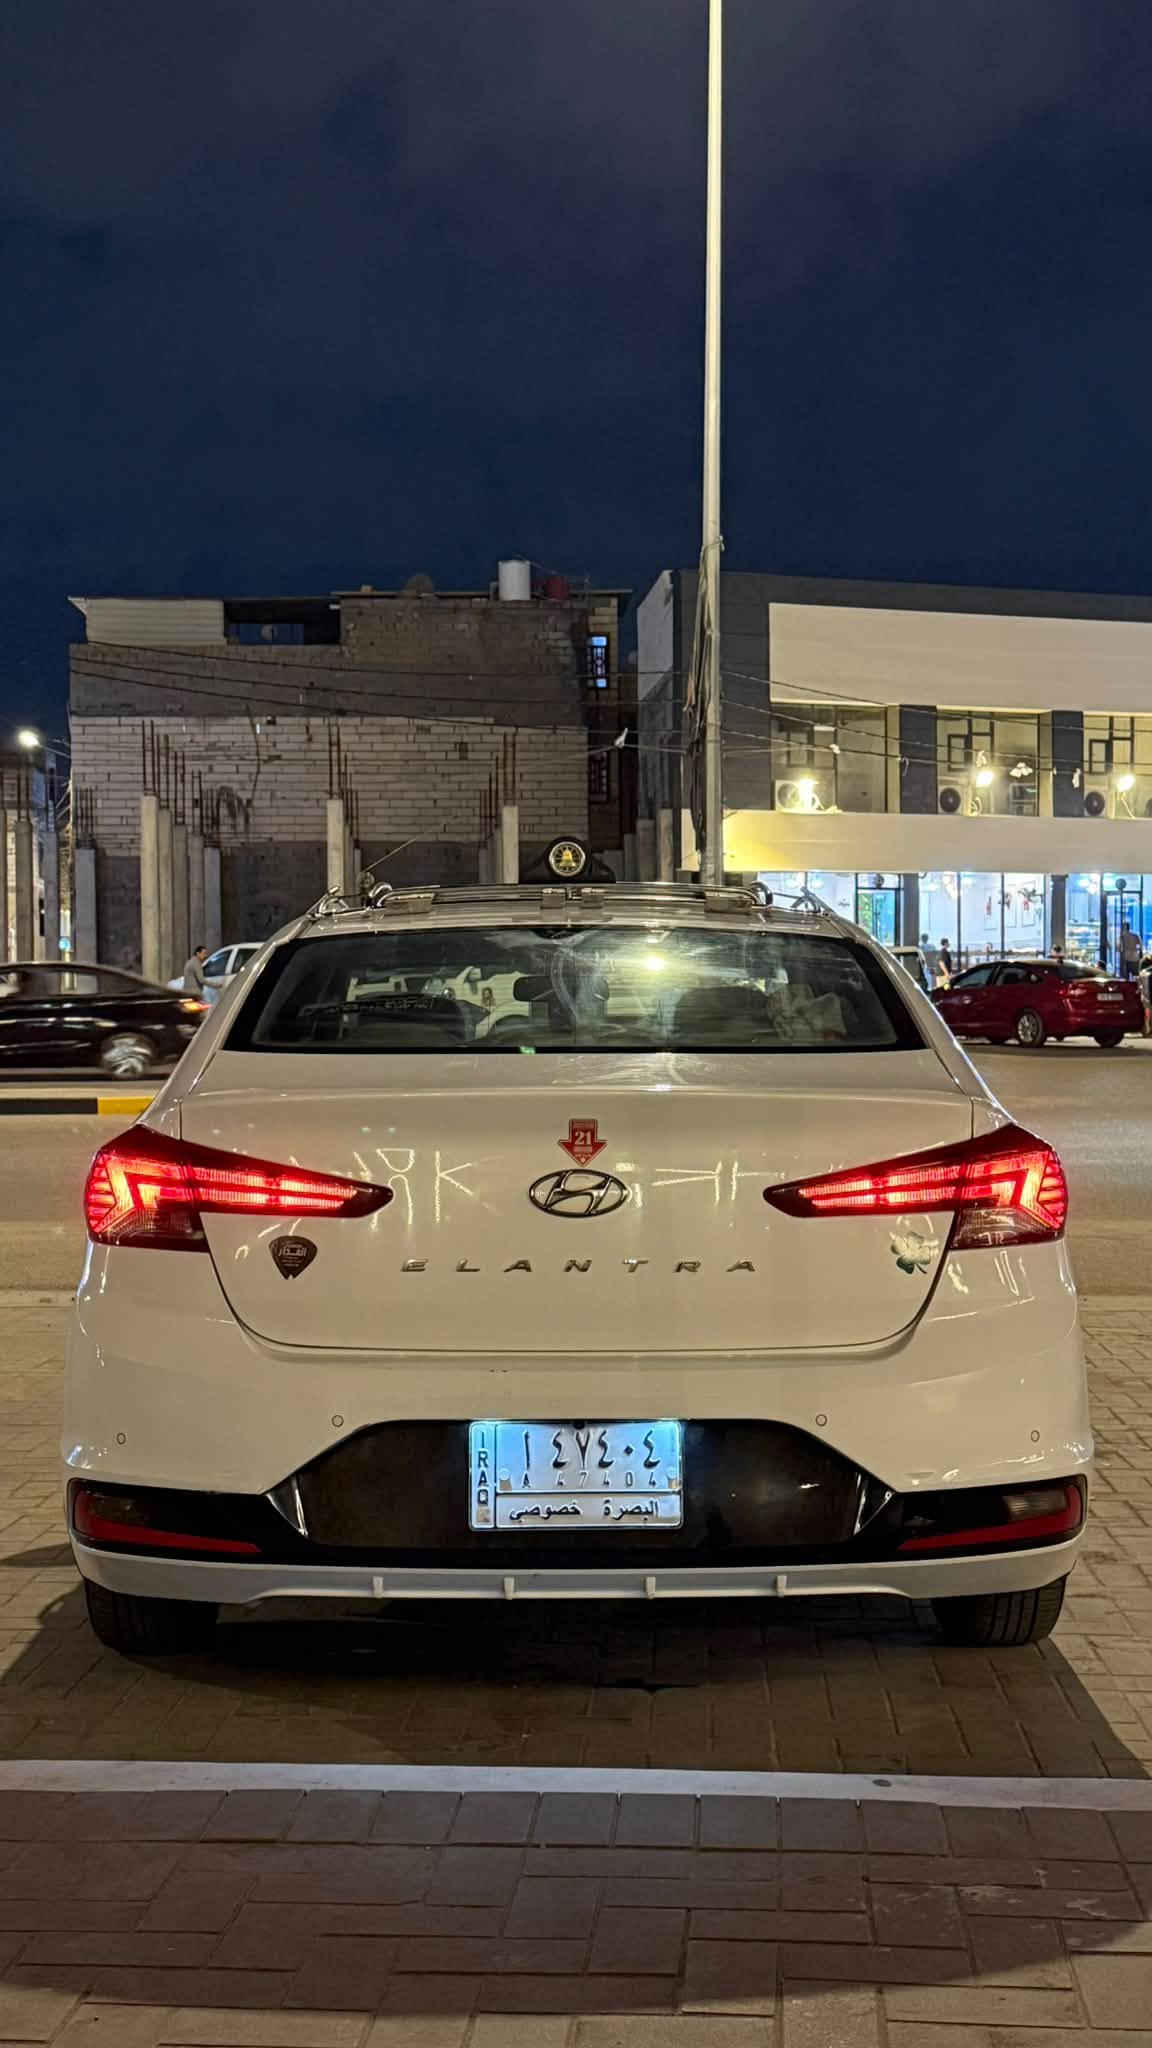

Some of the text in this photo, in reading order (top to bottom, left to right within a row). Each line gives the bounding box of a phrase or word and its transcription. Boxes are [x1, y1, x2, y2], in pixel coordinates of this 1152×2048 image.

[574, 1131, 592, 1145] 21
[400, 1258, 756, 1273] ELANTRA
[477, 1431, 489, 1505] IRAQ
[509, 1499, 659, 1523] البصرة خصوصي
